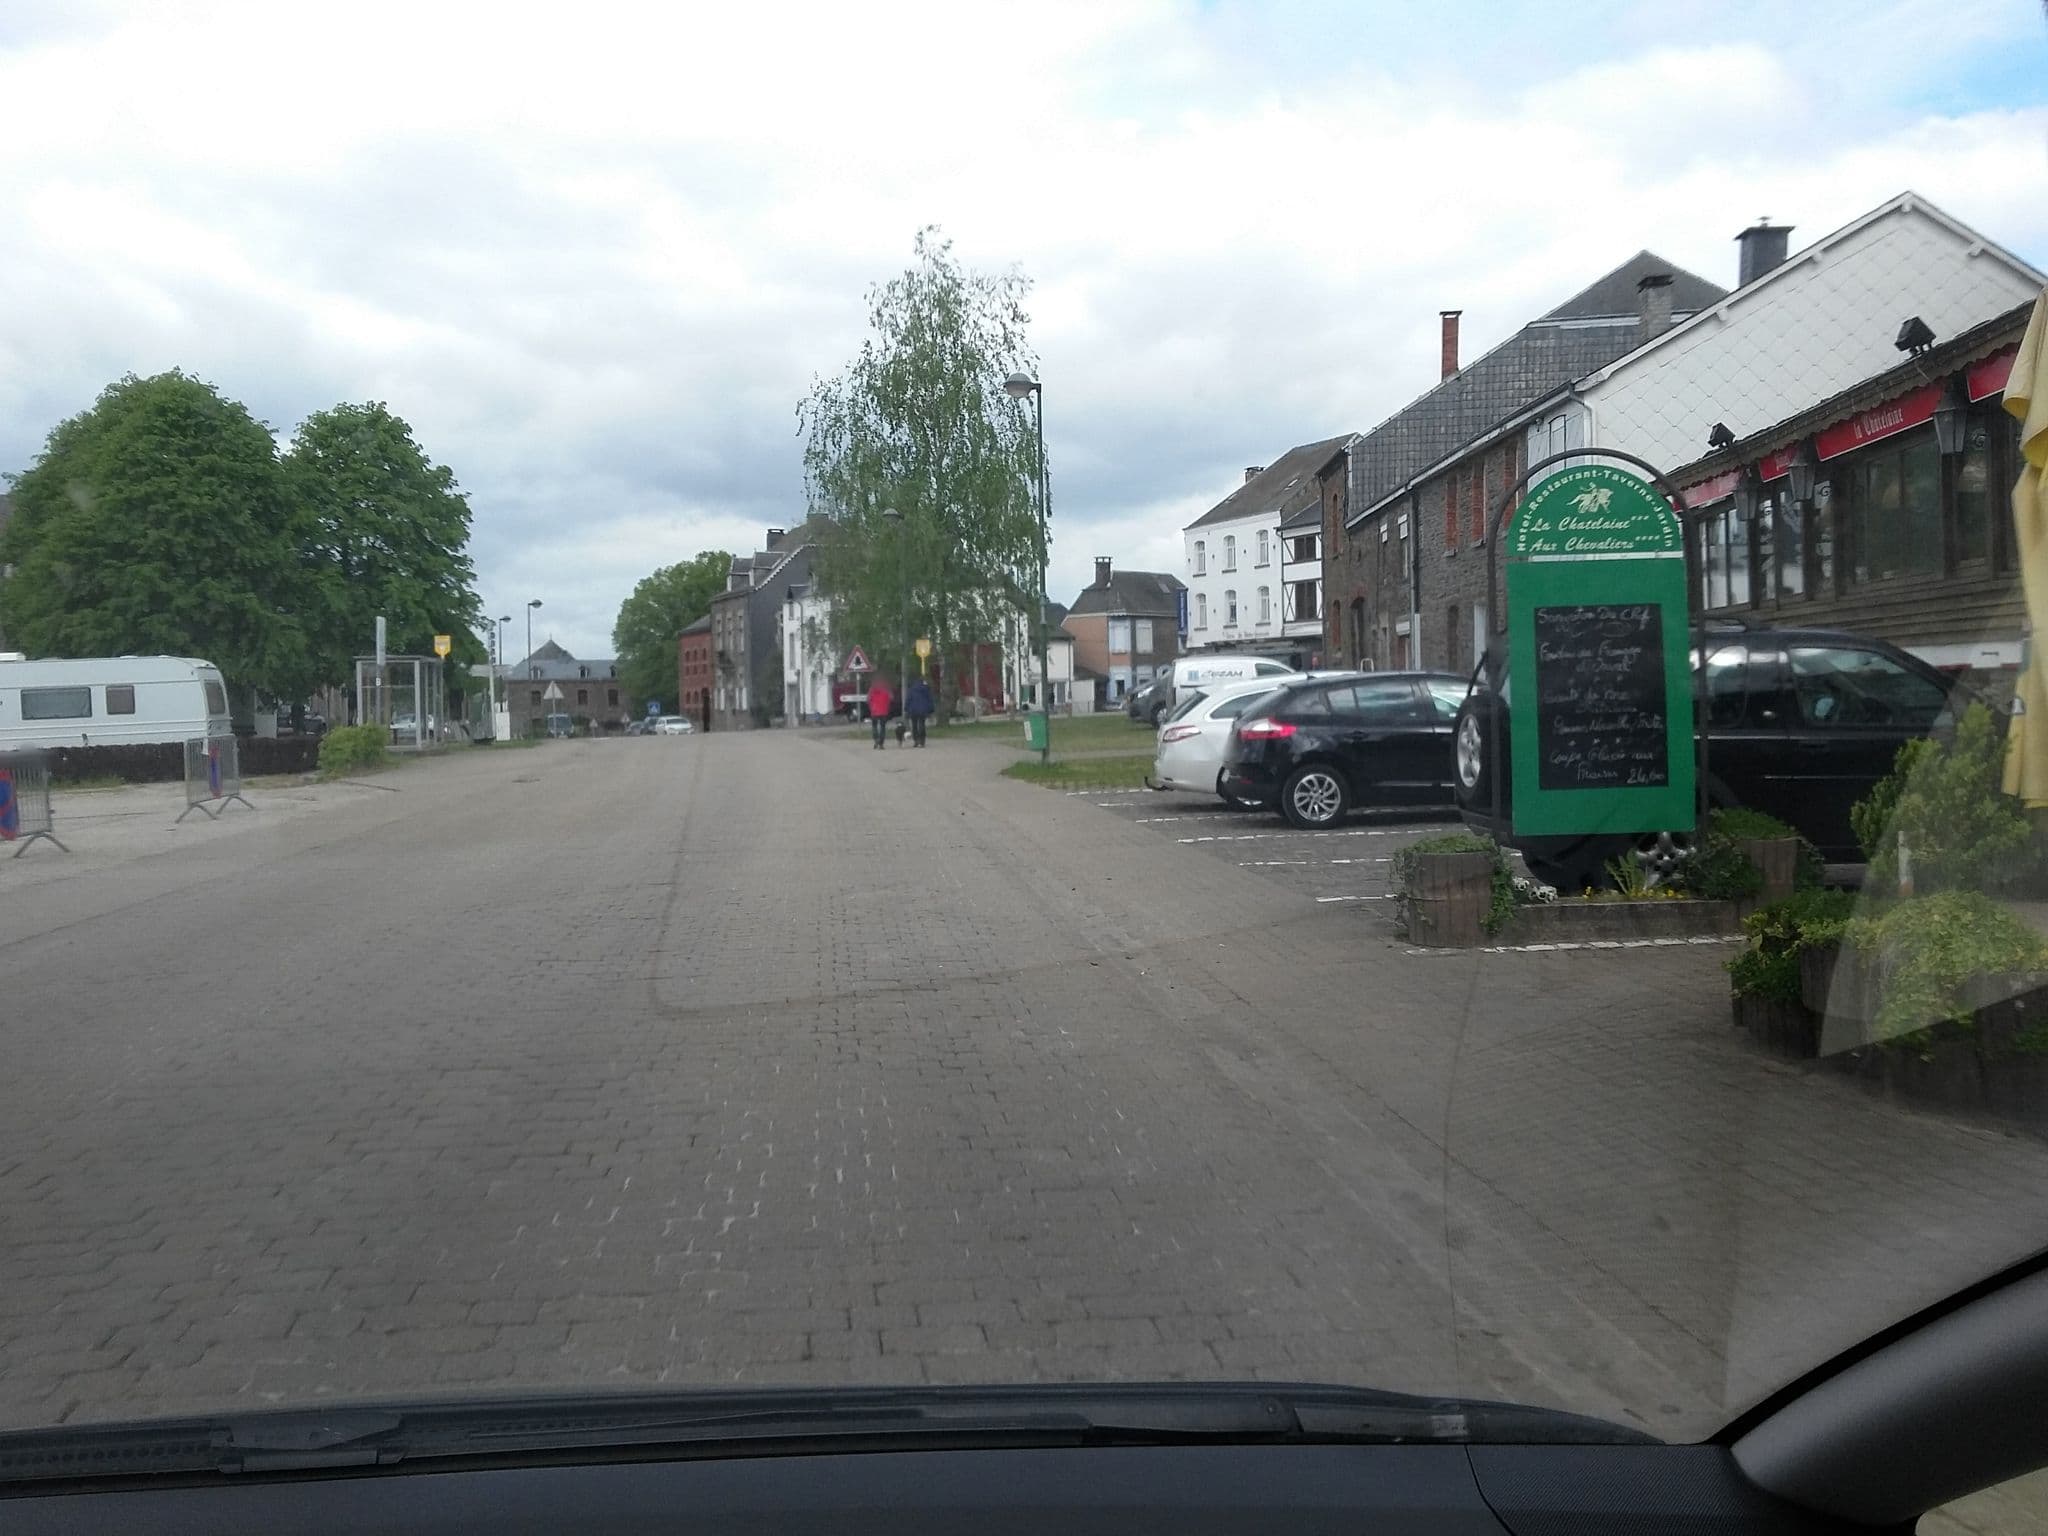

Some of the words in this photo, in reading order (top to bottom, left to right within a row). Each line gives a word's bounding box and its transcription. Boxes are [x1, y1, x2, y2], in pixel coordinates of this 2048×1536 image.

[1530, 518, 1552, 532] La
[1529, 538, 1558, 552] Aux
[1565, 537, 1635, 552] Chevaliers
